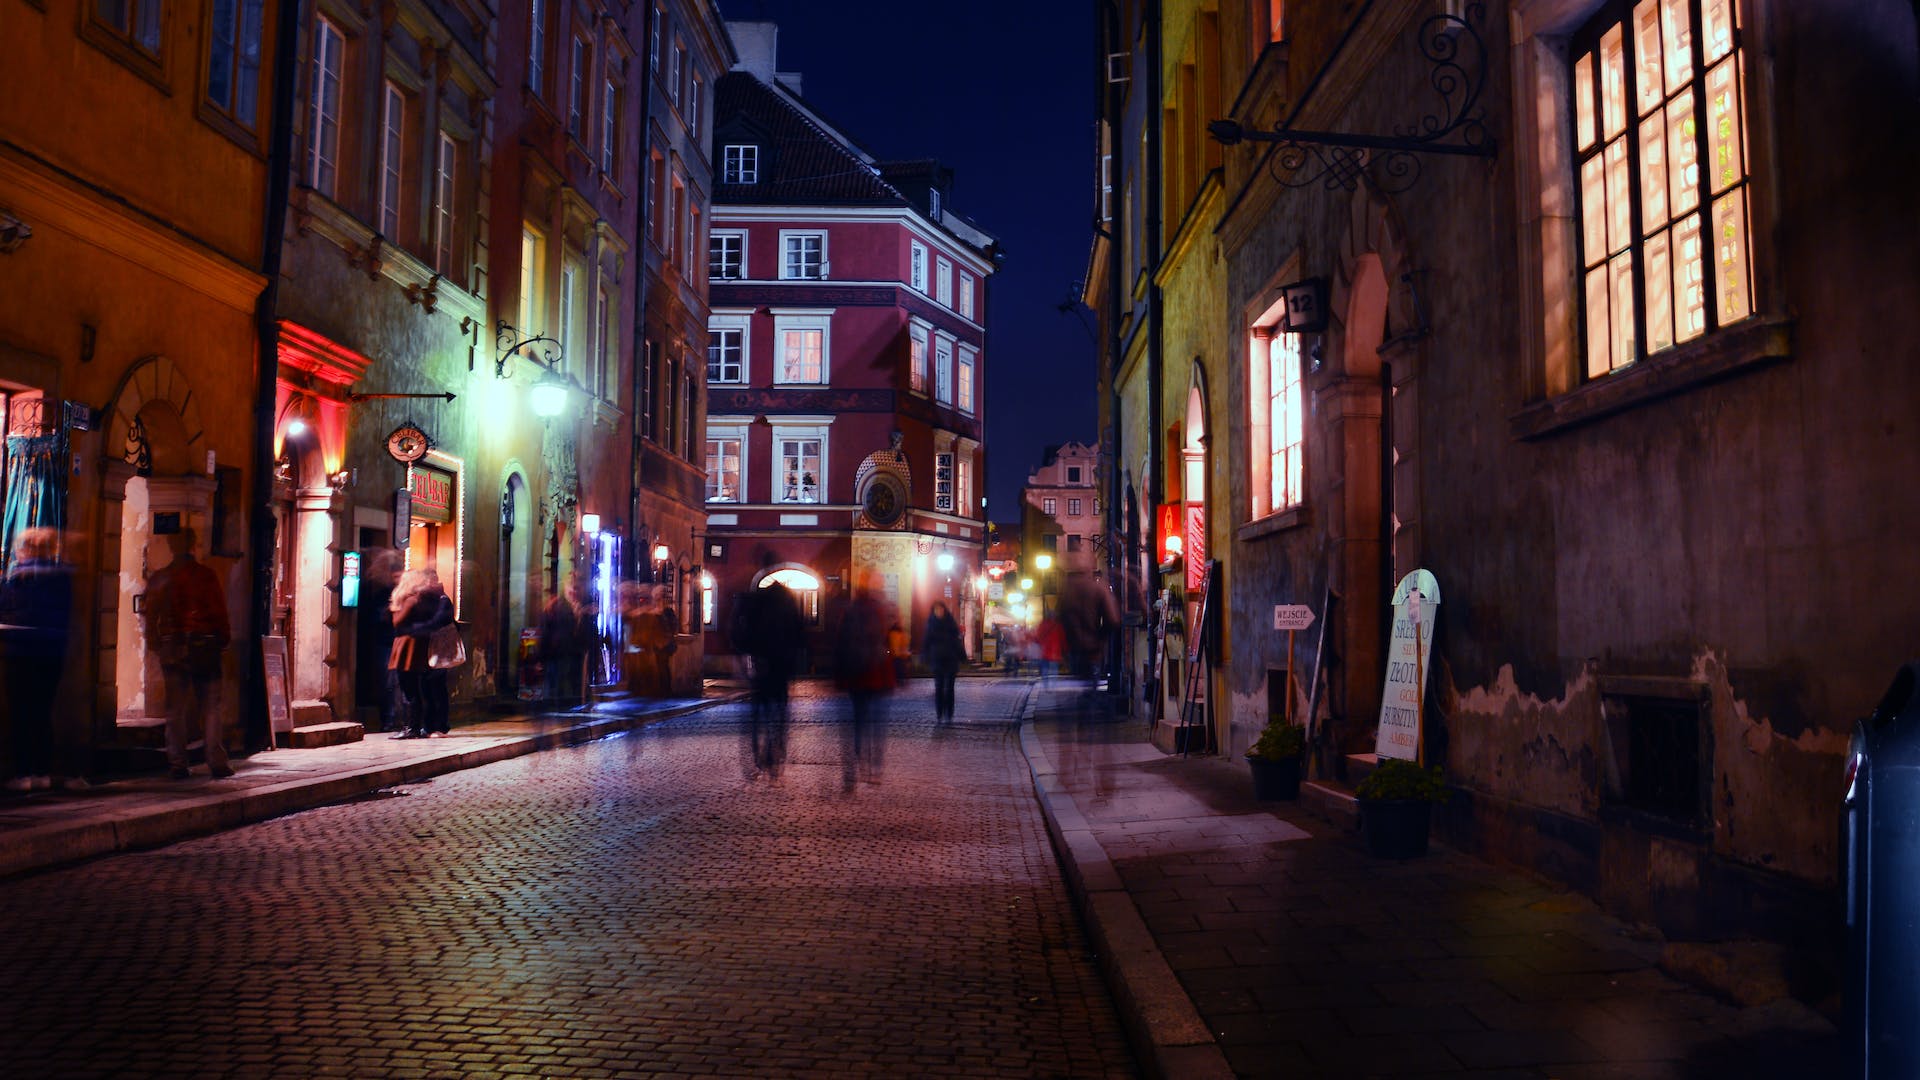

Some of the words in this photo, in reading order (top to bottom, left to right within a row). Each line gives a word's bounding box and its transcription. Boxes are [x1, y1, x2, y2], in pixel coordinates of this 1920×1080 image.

[1290, 294, 1312, 312] 12
[391, 430, 425, 445] CELIBAR
[938, 455, 949, 466] EX
[937, 468, 950, 480] CH
[938, 482, 949, 493] AN
[937, 496, 950, 508] GE
[1277, 608, 1308, 619] WEJŚCIE
[1395, 619, 1431, 640] SREBO
[1400, 689, 1418, 702] GOL
